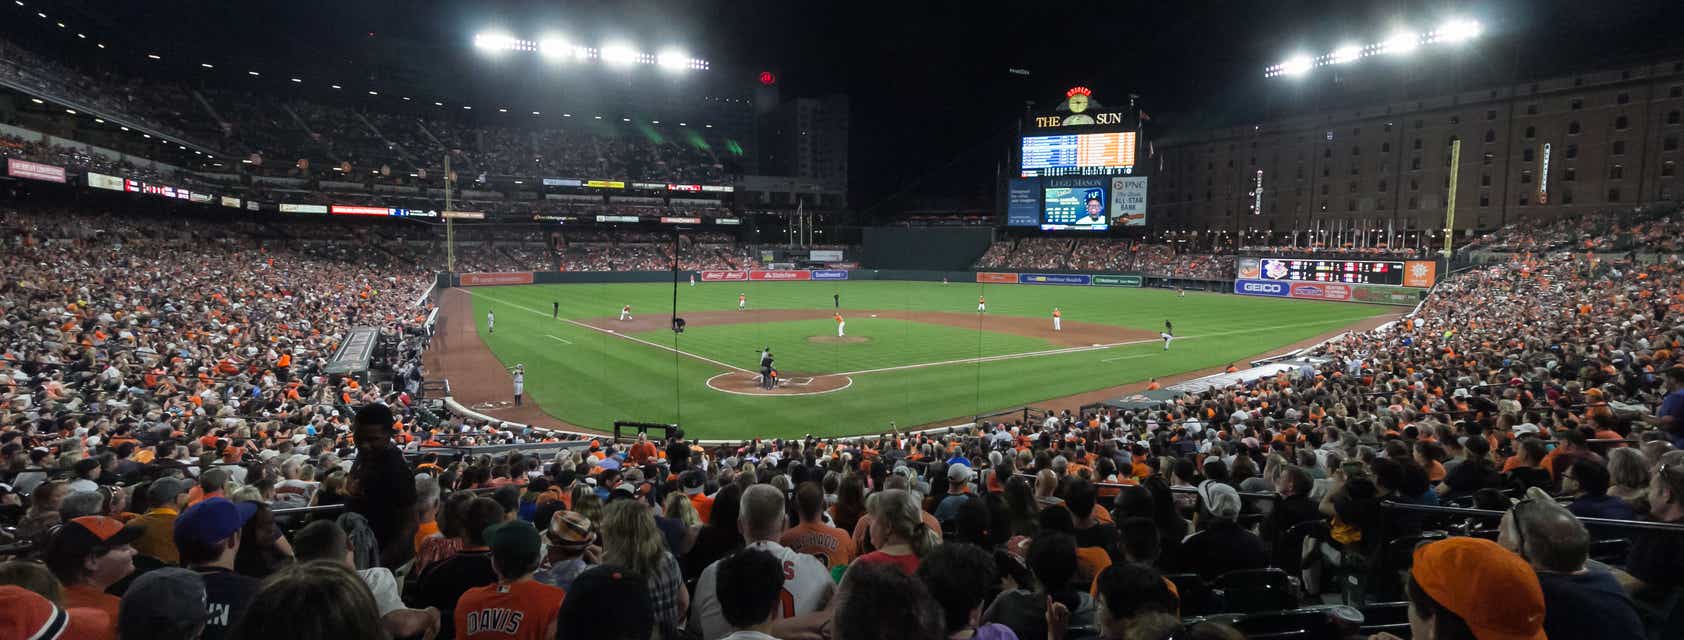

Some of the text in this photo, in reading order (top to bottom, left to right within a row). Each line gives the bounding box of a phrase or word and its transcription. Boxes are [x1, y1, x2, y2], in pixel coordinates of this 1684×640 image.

[1036, 113, 1121, 127] THE SUN
[1124, 181, 1145, 189] PNC
[1244, 283, 1281, 293] GEICO
[467, 608, 523, 635] DAVIS
